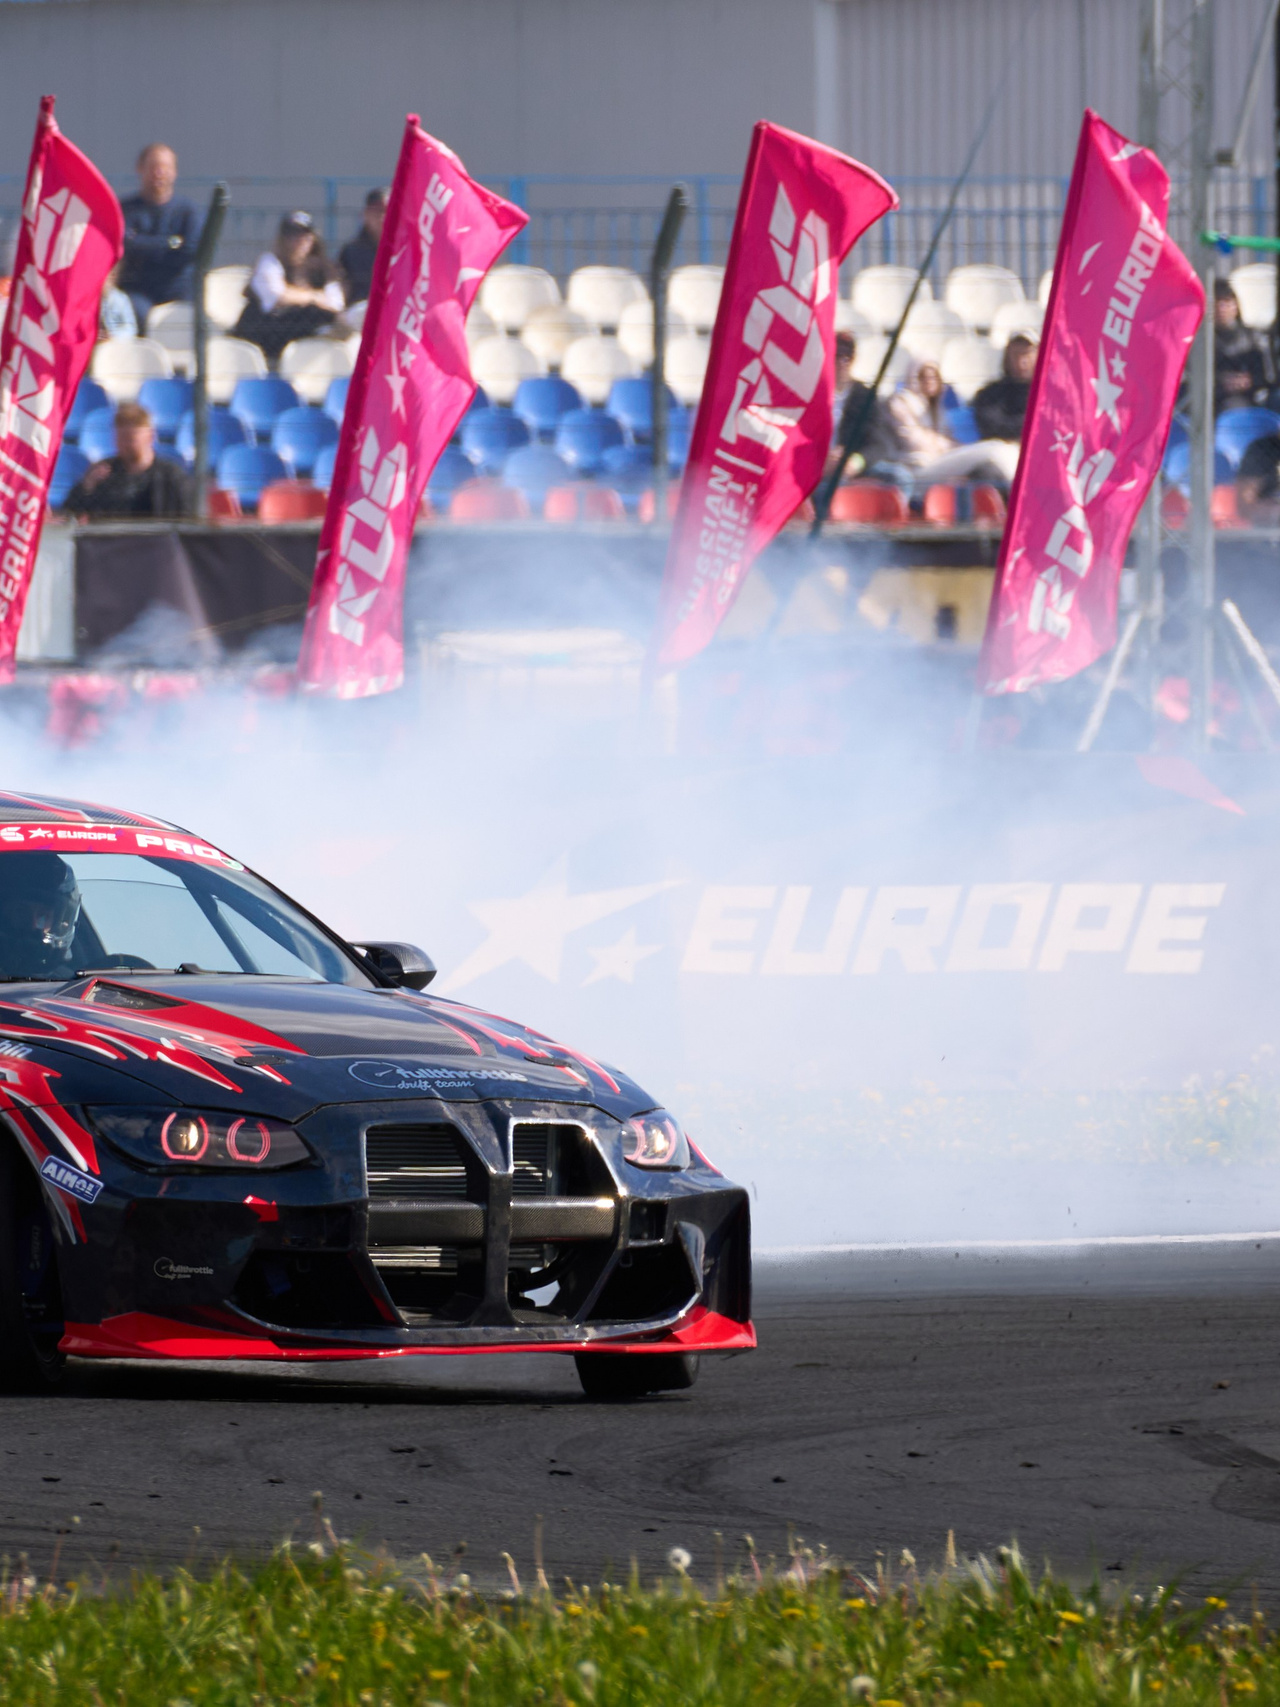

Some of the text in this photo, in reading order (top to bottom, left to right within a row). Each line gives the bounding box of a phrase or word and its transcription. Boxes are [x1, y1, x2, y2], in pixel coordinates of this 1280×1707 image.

[719, 181, 831, 454] RDS
[328, 424, 408, 647] RDS
[1027, 433, 1117, 640] RDS
[57, 829, 117, 841] EUROPE
[135, 833, 220, 860] PRO
[681, 881, 1227, 975] EUROPE
[396, 1068, 529, 1082] fullthrottle
[398, 1080, 474, 1090] drift team
